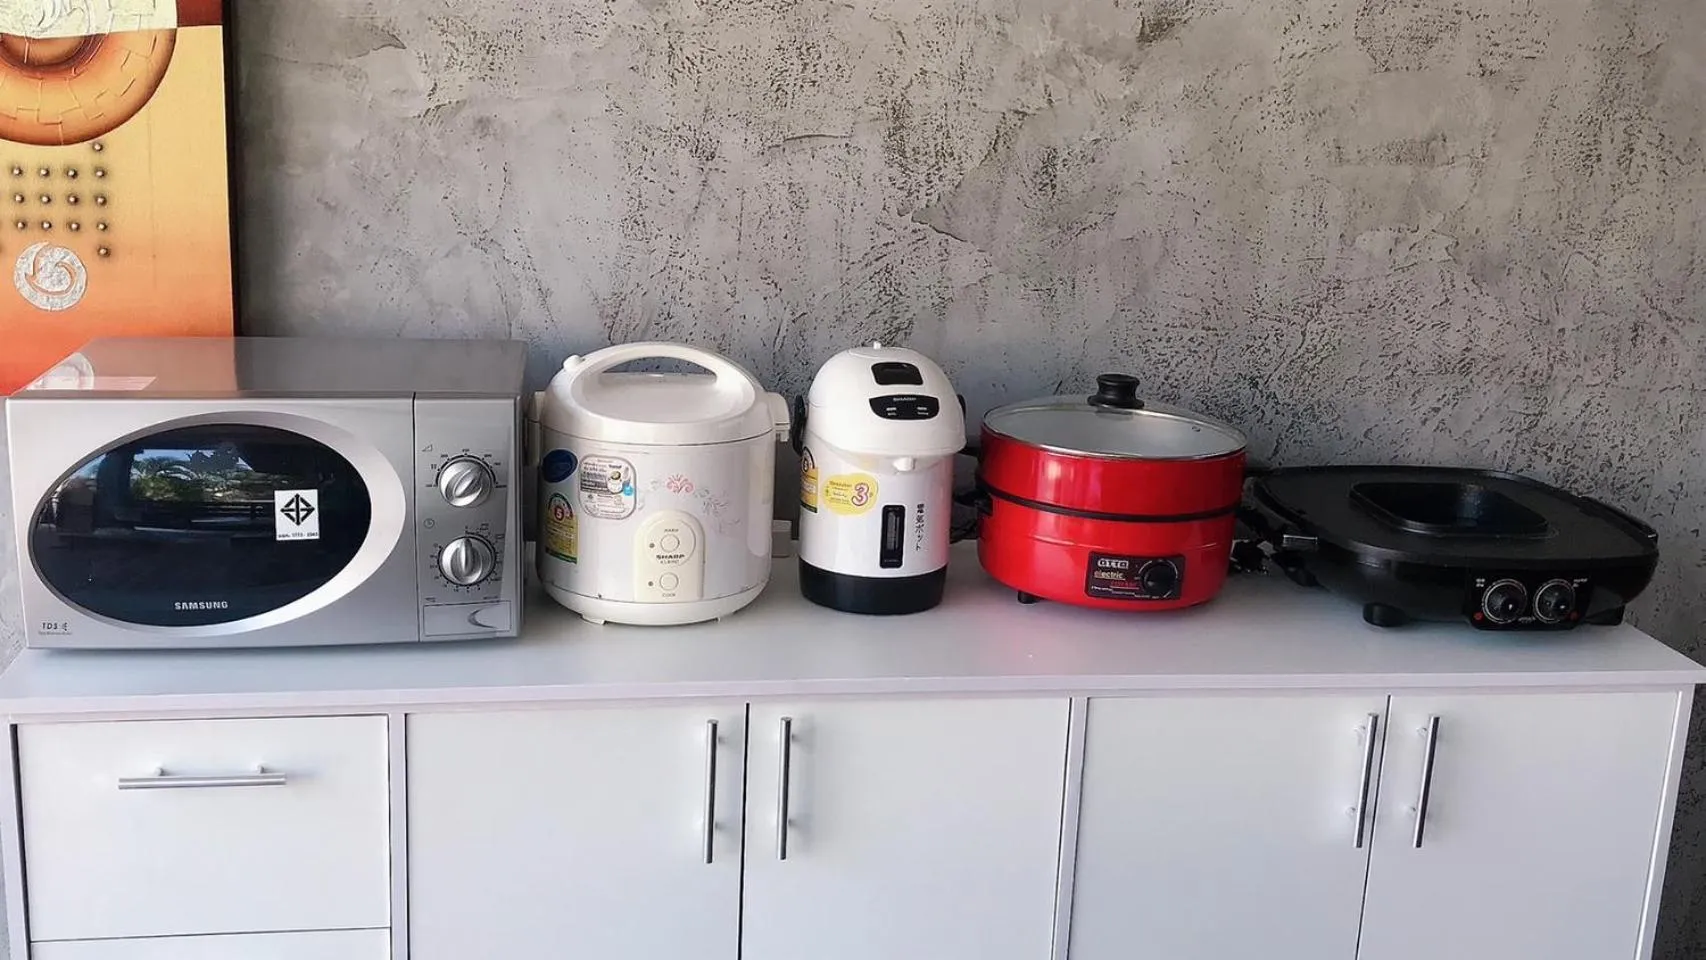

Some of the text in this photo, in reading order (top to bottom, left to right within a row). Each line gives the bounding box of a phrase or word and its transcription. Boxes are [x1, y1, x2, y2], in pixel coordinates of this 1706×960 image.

[852, 482, 870, 507] 3
[1094, 570, 1124, 580] electric
[174, 601, 229, 610] SAMSUNG
